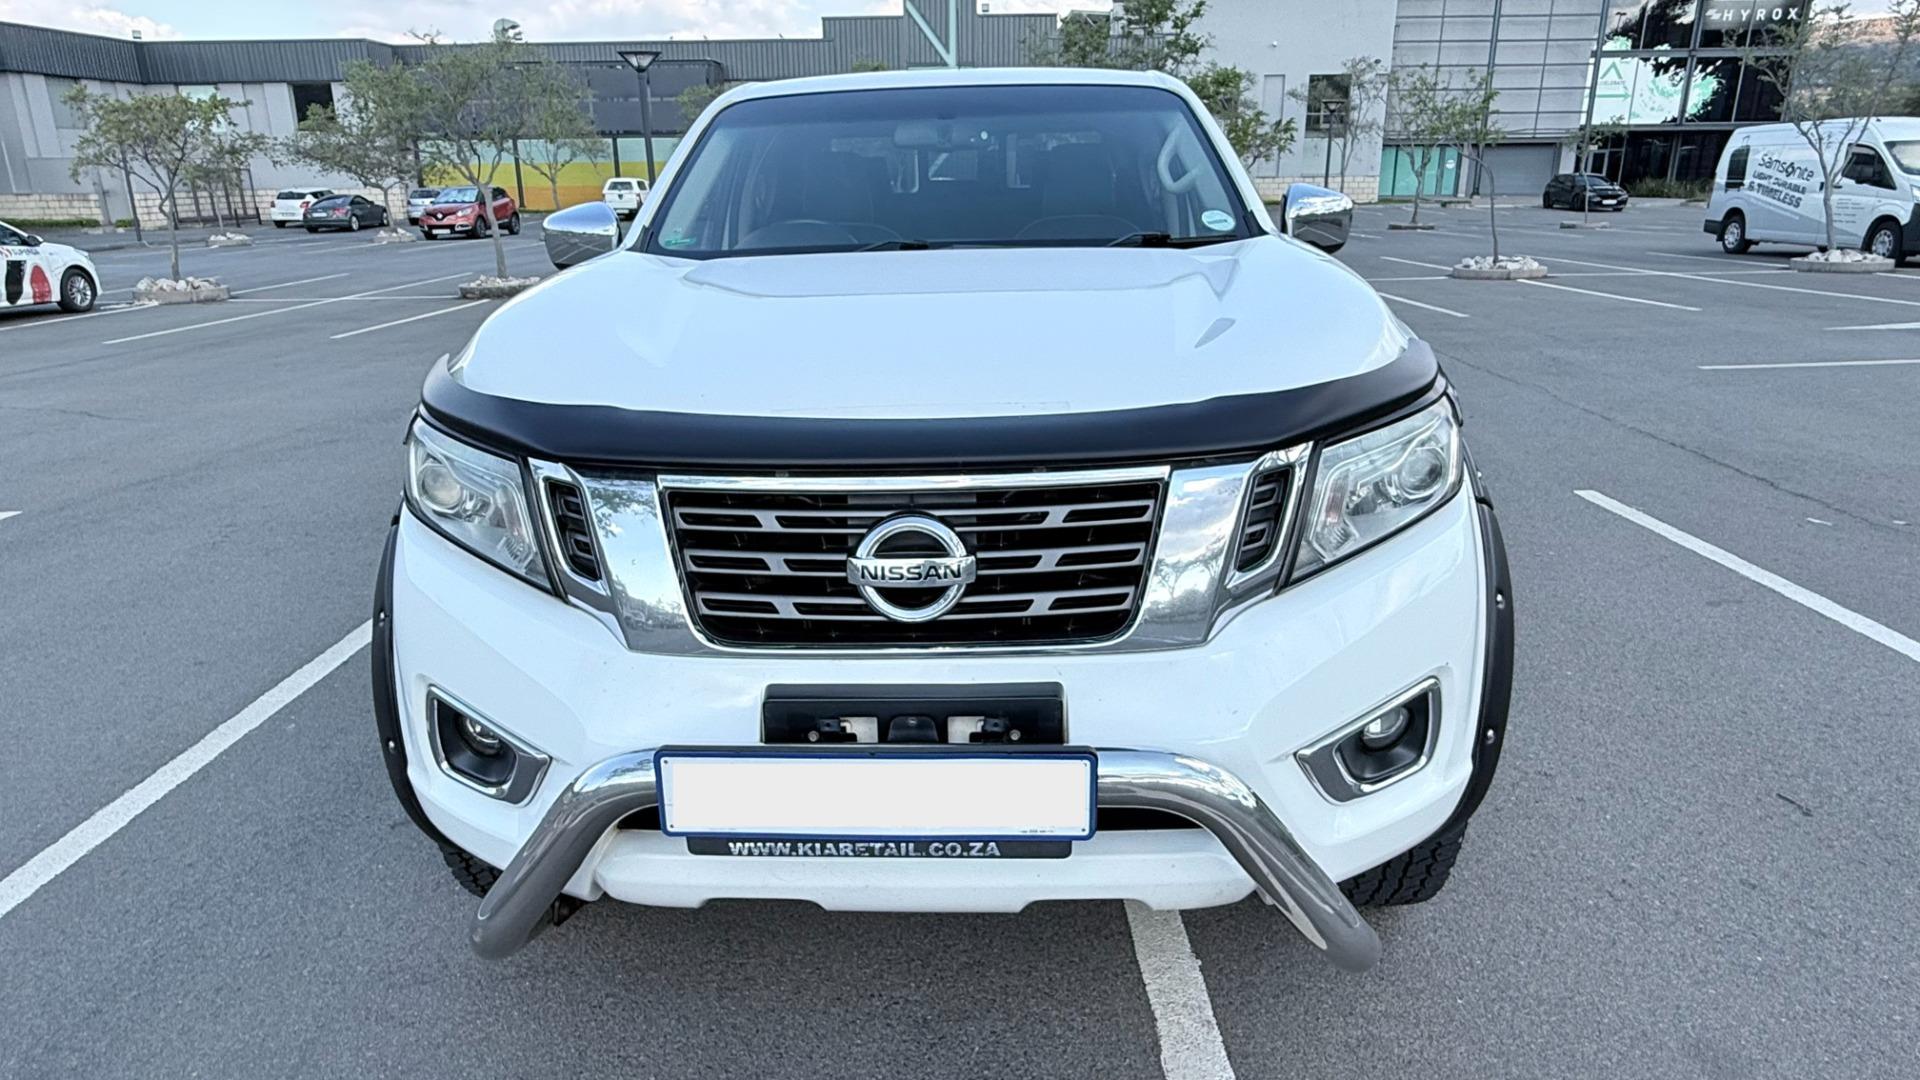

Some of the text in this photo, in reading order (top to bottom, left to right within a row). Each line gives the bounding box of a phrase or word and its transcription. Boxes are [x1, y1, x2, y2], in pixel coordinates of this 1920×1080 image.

[1723, 8, 1798, 21] HYROX
[1758, 153, 1814, 181] Samsonite
[1757, 183, 1803, 208] TIMELESS
[860, 564, 962, 581] NISSAN
[728, 842, 1001, 857] WWW.KIARETAIL.CO.ZA
